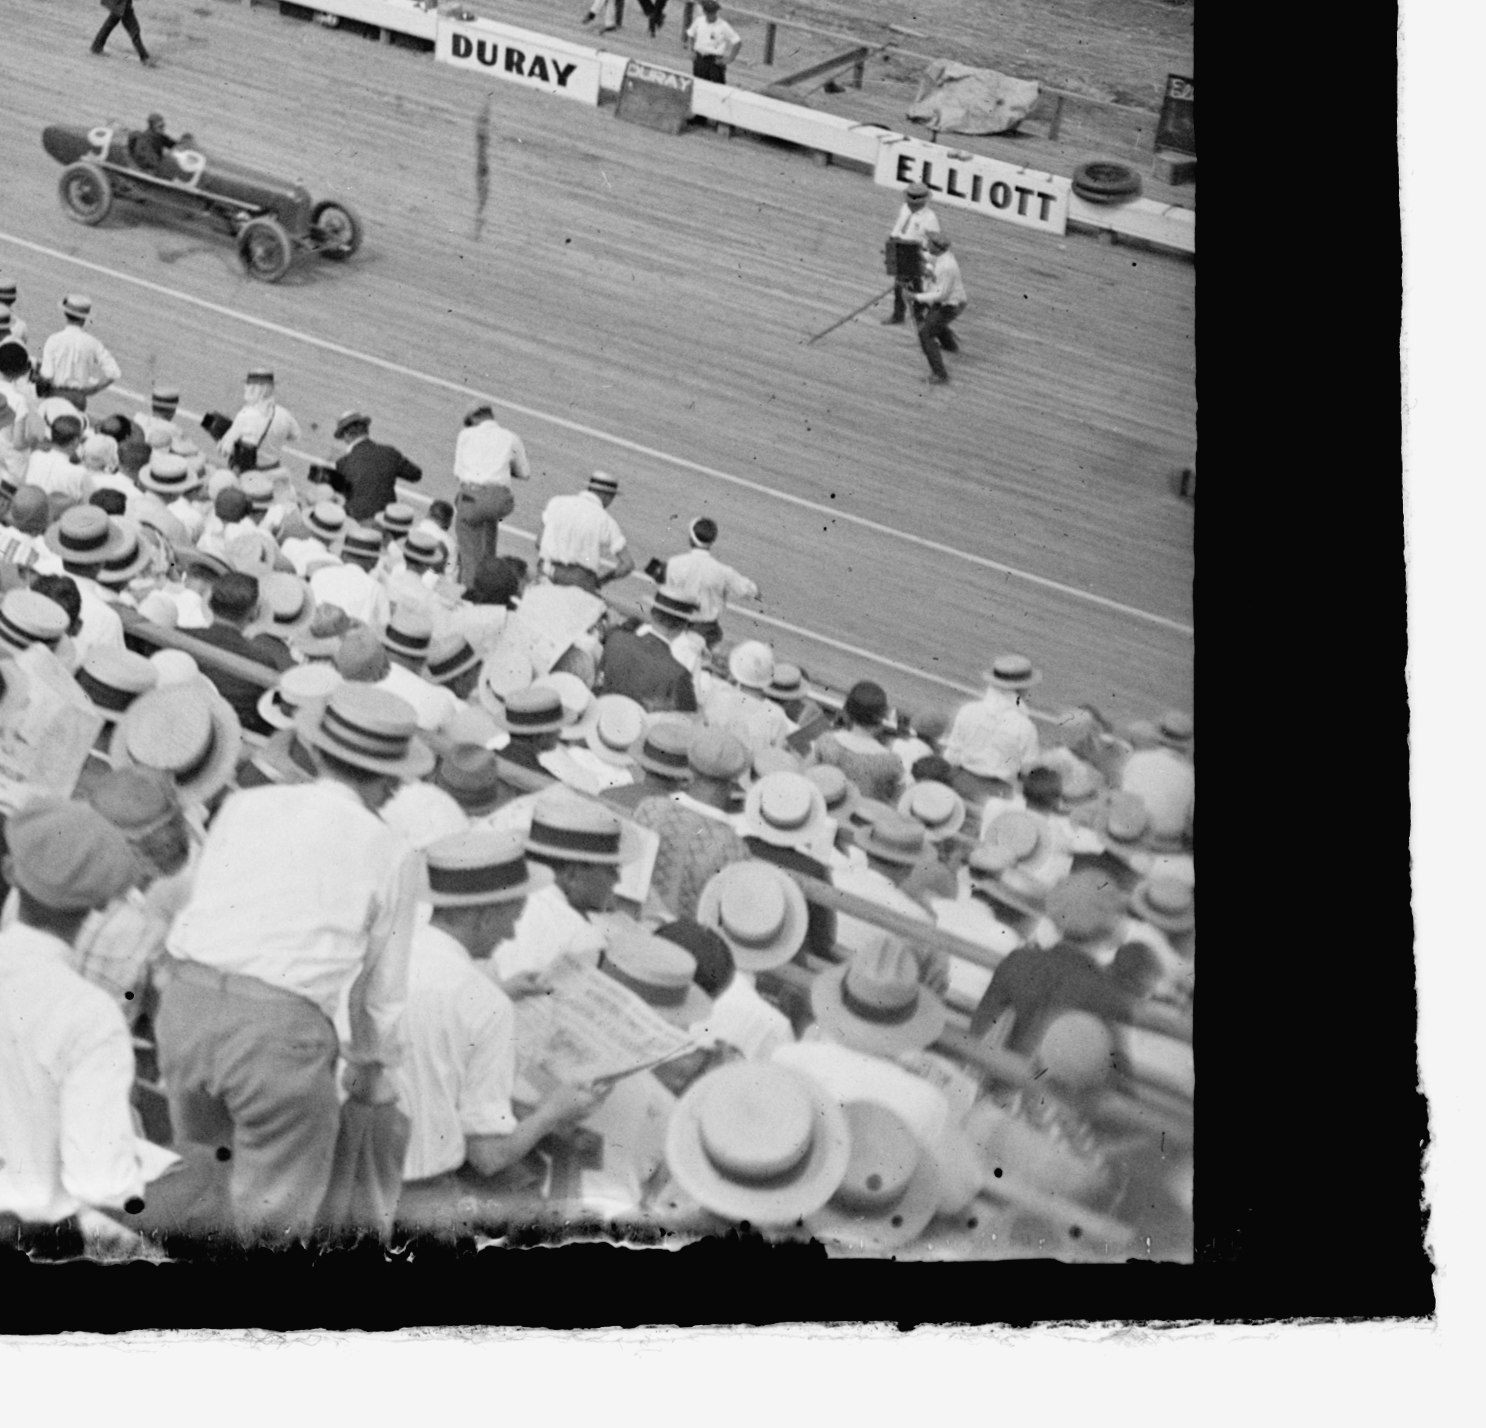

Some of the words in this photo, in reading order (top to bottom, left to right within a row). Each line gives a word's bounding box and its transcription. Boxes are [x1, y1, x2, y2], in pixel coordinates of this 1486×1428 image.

[451, 32, 578, 88] DURAY
[626, 63, 693, 92] DURAY
[80, 126, 114, 163] 9
[173, 149, 207, 187] 9
[895, 153, 1058, 222] ELLIOTT
